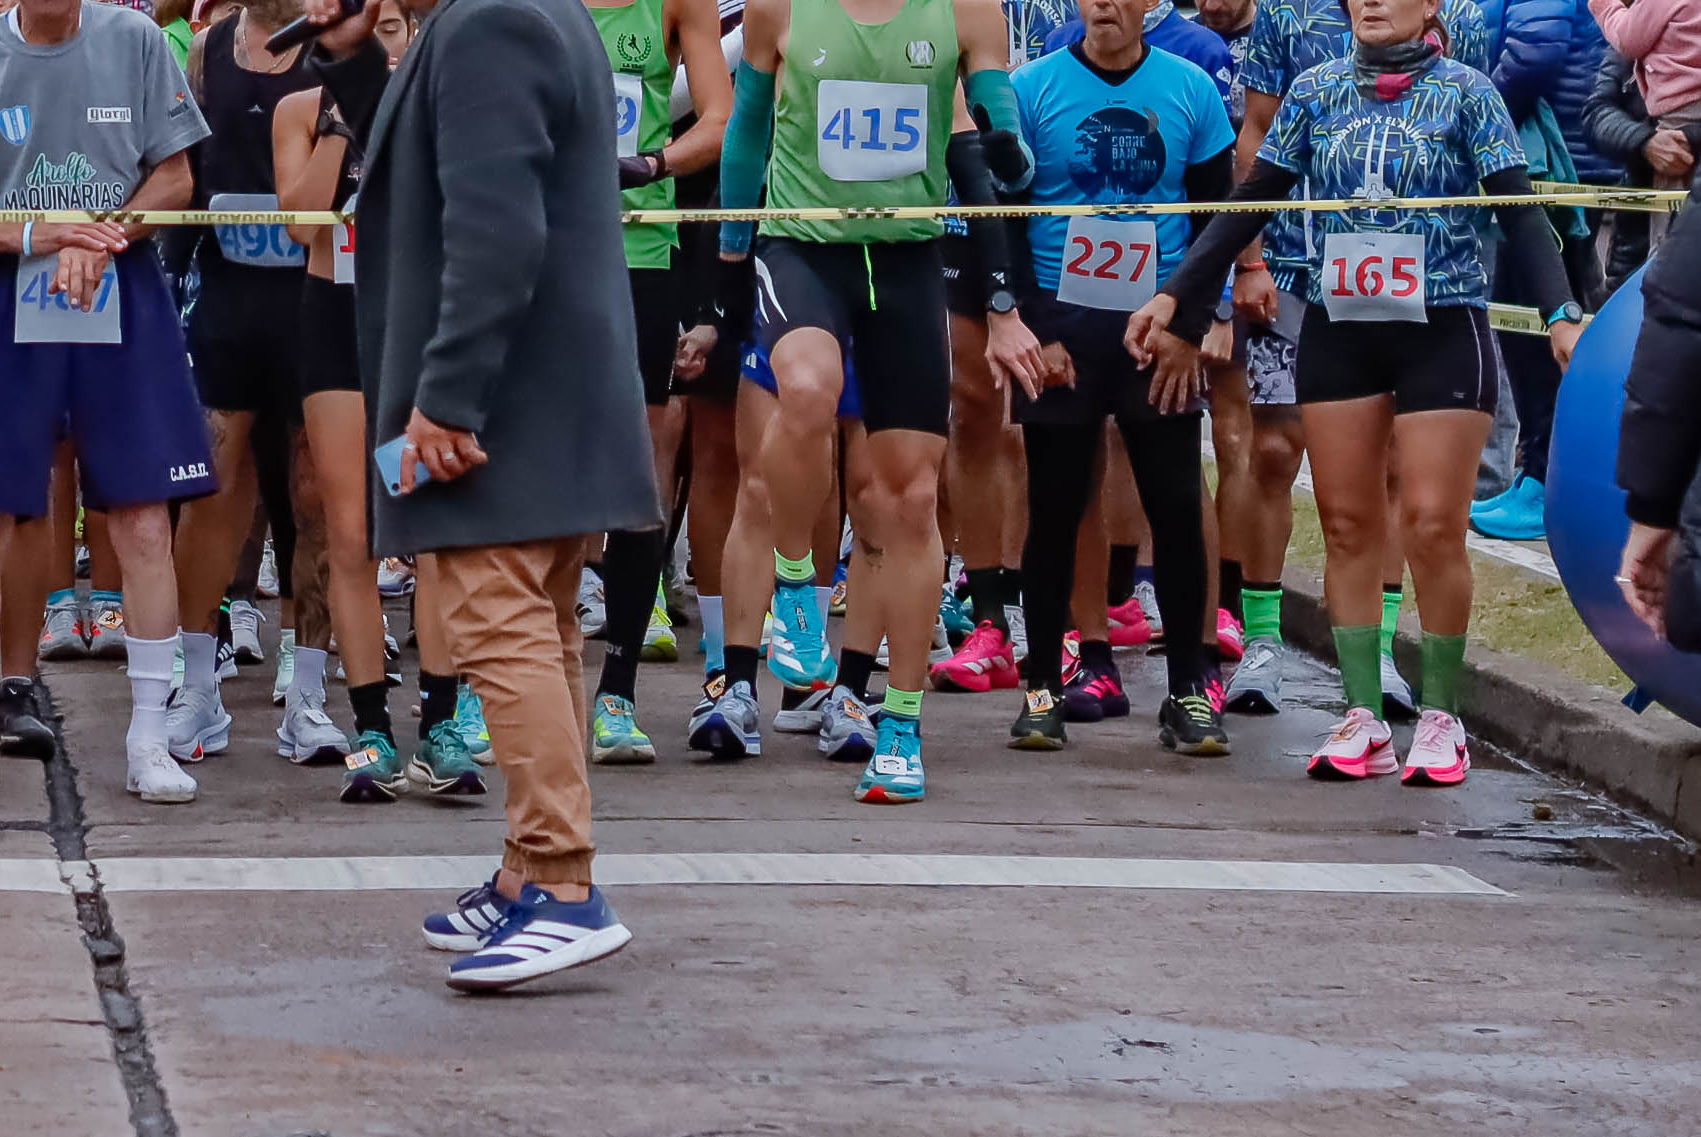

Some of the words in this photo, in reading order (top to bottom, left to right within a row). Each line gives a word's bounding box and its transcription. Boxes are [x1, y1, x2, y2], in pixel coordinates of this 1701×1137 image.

[822, 107, 920, 152] 415
[4, 182, 124, 211] MAQUINARIAS
[1066, 236, 1151, 282] 227
[1330, 256, 1419, 298] 165
